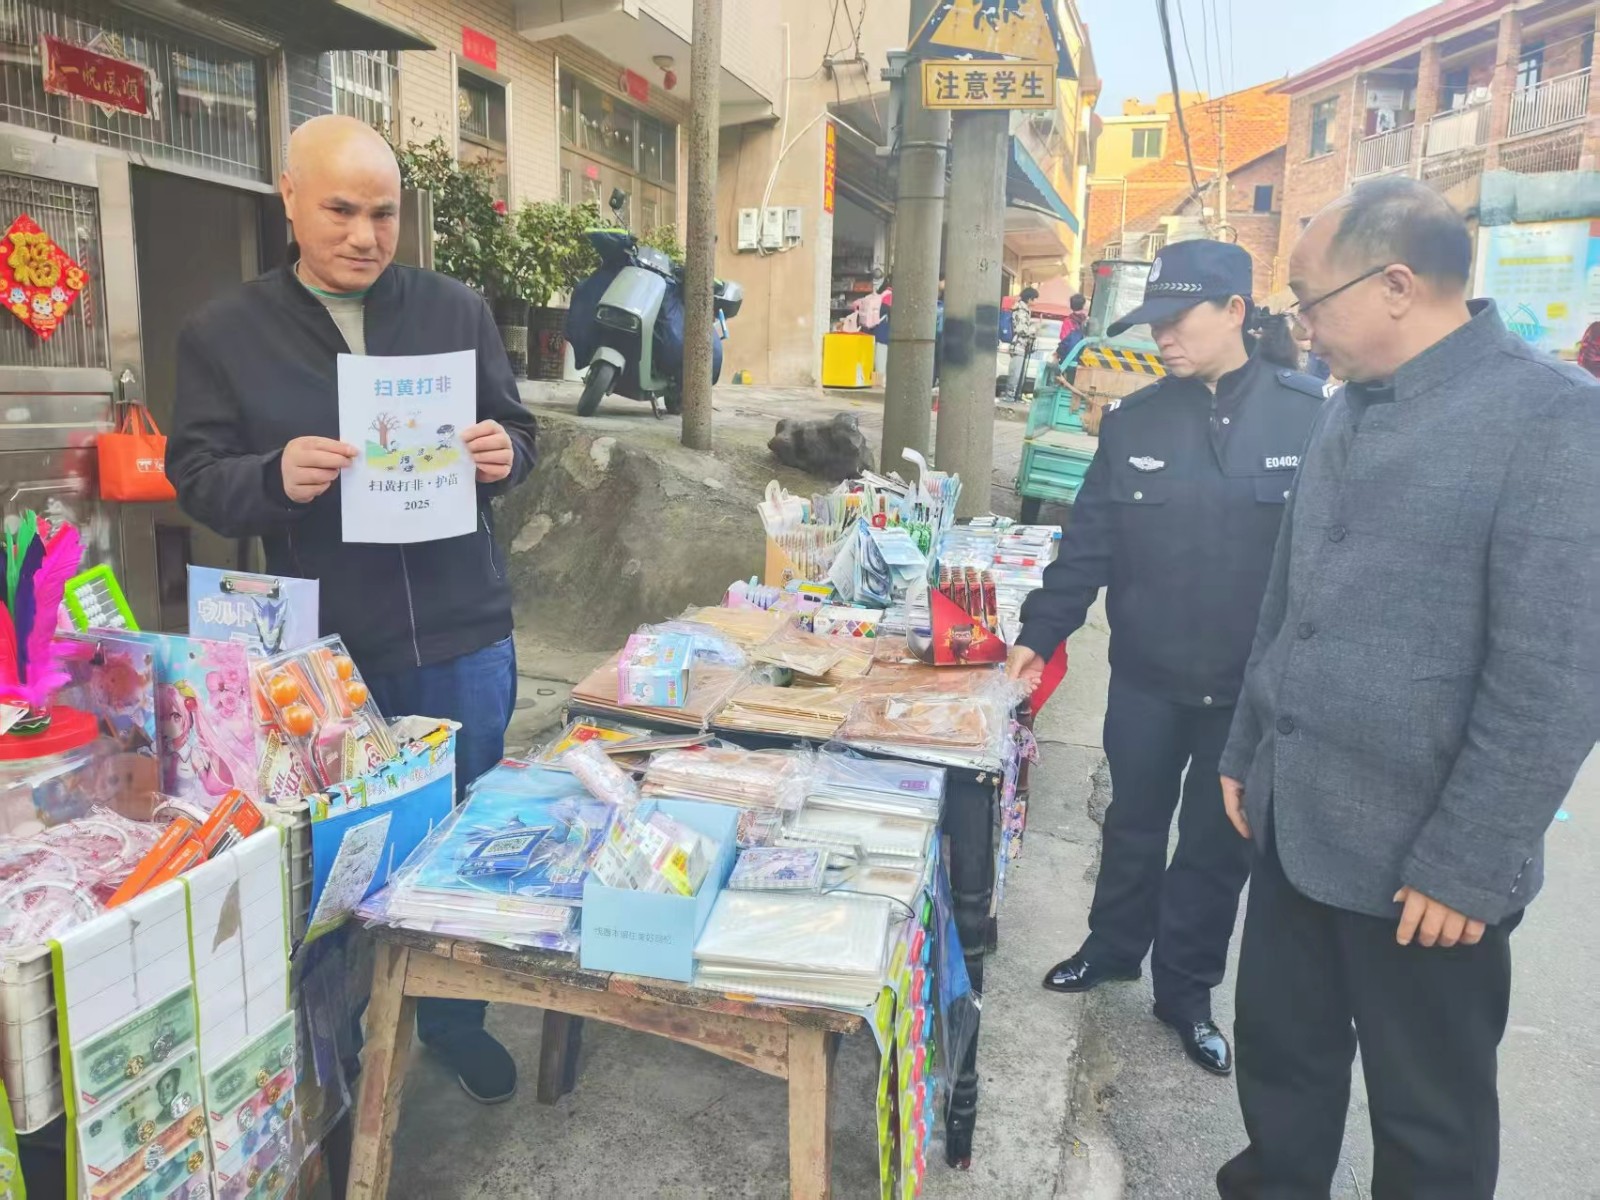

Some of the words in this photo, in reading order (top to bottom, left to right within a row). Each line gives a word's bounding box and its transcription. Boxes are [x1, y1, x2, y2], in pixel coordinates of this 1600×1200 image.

[935, 71, 1044, 99] 注意学生
[8, 232, 60, 288] 福
[374, 375, 452, 396] 扫黄打非
[1265, 455, 1301, 468] E0402
[368, 474, 458, 492] 扫黄打非·护苗
[404, 499, 430, 511] 2025
